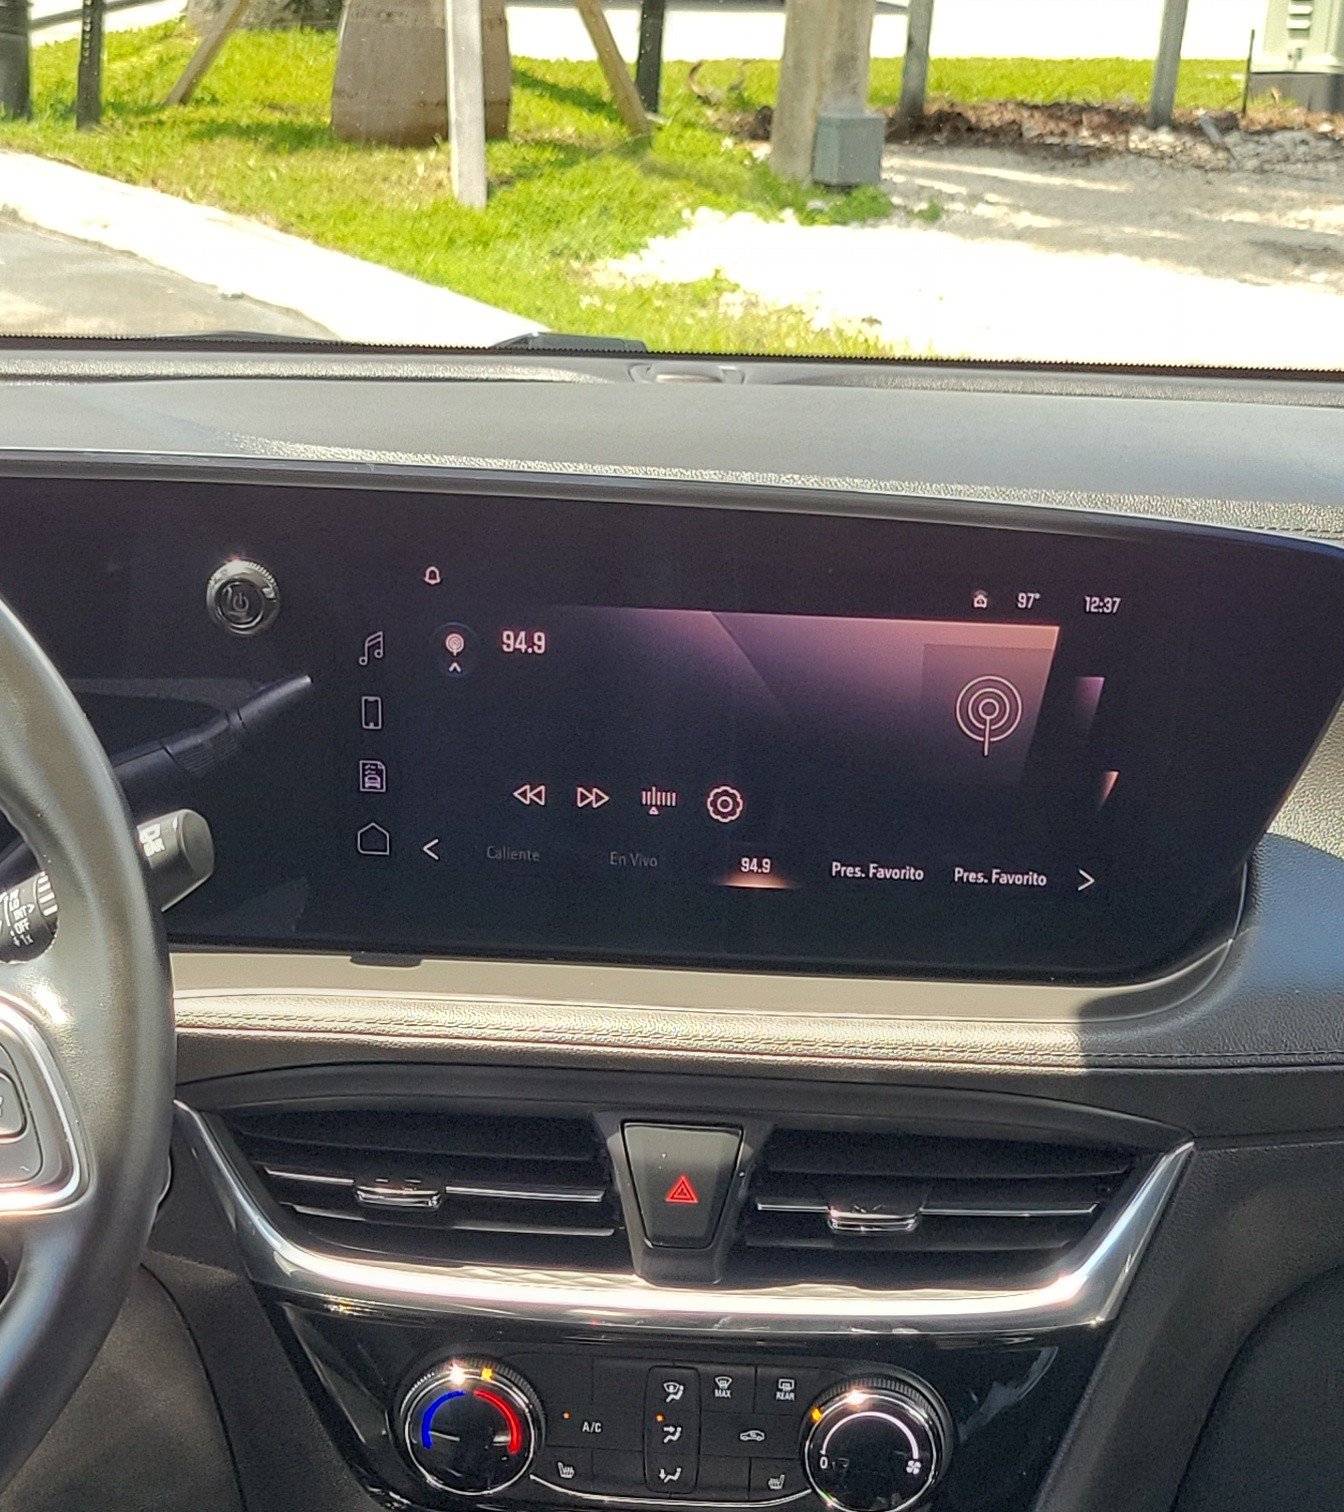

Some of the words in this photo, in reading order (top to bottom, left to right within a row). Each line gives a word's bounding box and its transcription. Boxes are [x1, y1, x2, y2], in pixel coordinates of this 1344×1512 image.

[1085, 596, 1121, 613] 12:37
[502, 630, 546, 654] 94.9
[486, 846, 540, 861] Caliente
[609, 851, 627, 865] En
[630, 853, 658, 867] Vivo
[741, 857, 771, 873] 94.9
[832, 861, 866, 877] Pres.
[869, 864, 924, 881] Favorito
[954, 867, 988, 883] Pres.
[991, 869, 1047, 886] Favorito
[14, 918, 30, 935] OFF
[715, 1389, 732, 1398] MAX
[776, 1390, 795, 1400] REAR
[582, 1421, 602, 1433] A/C
